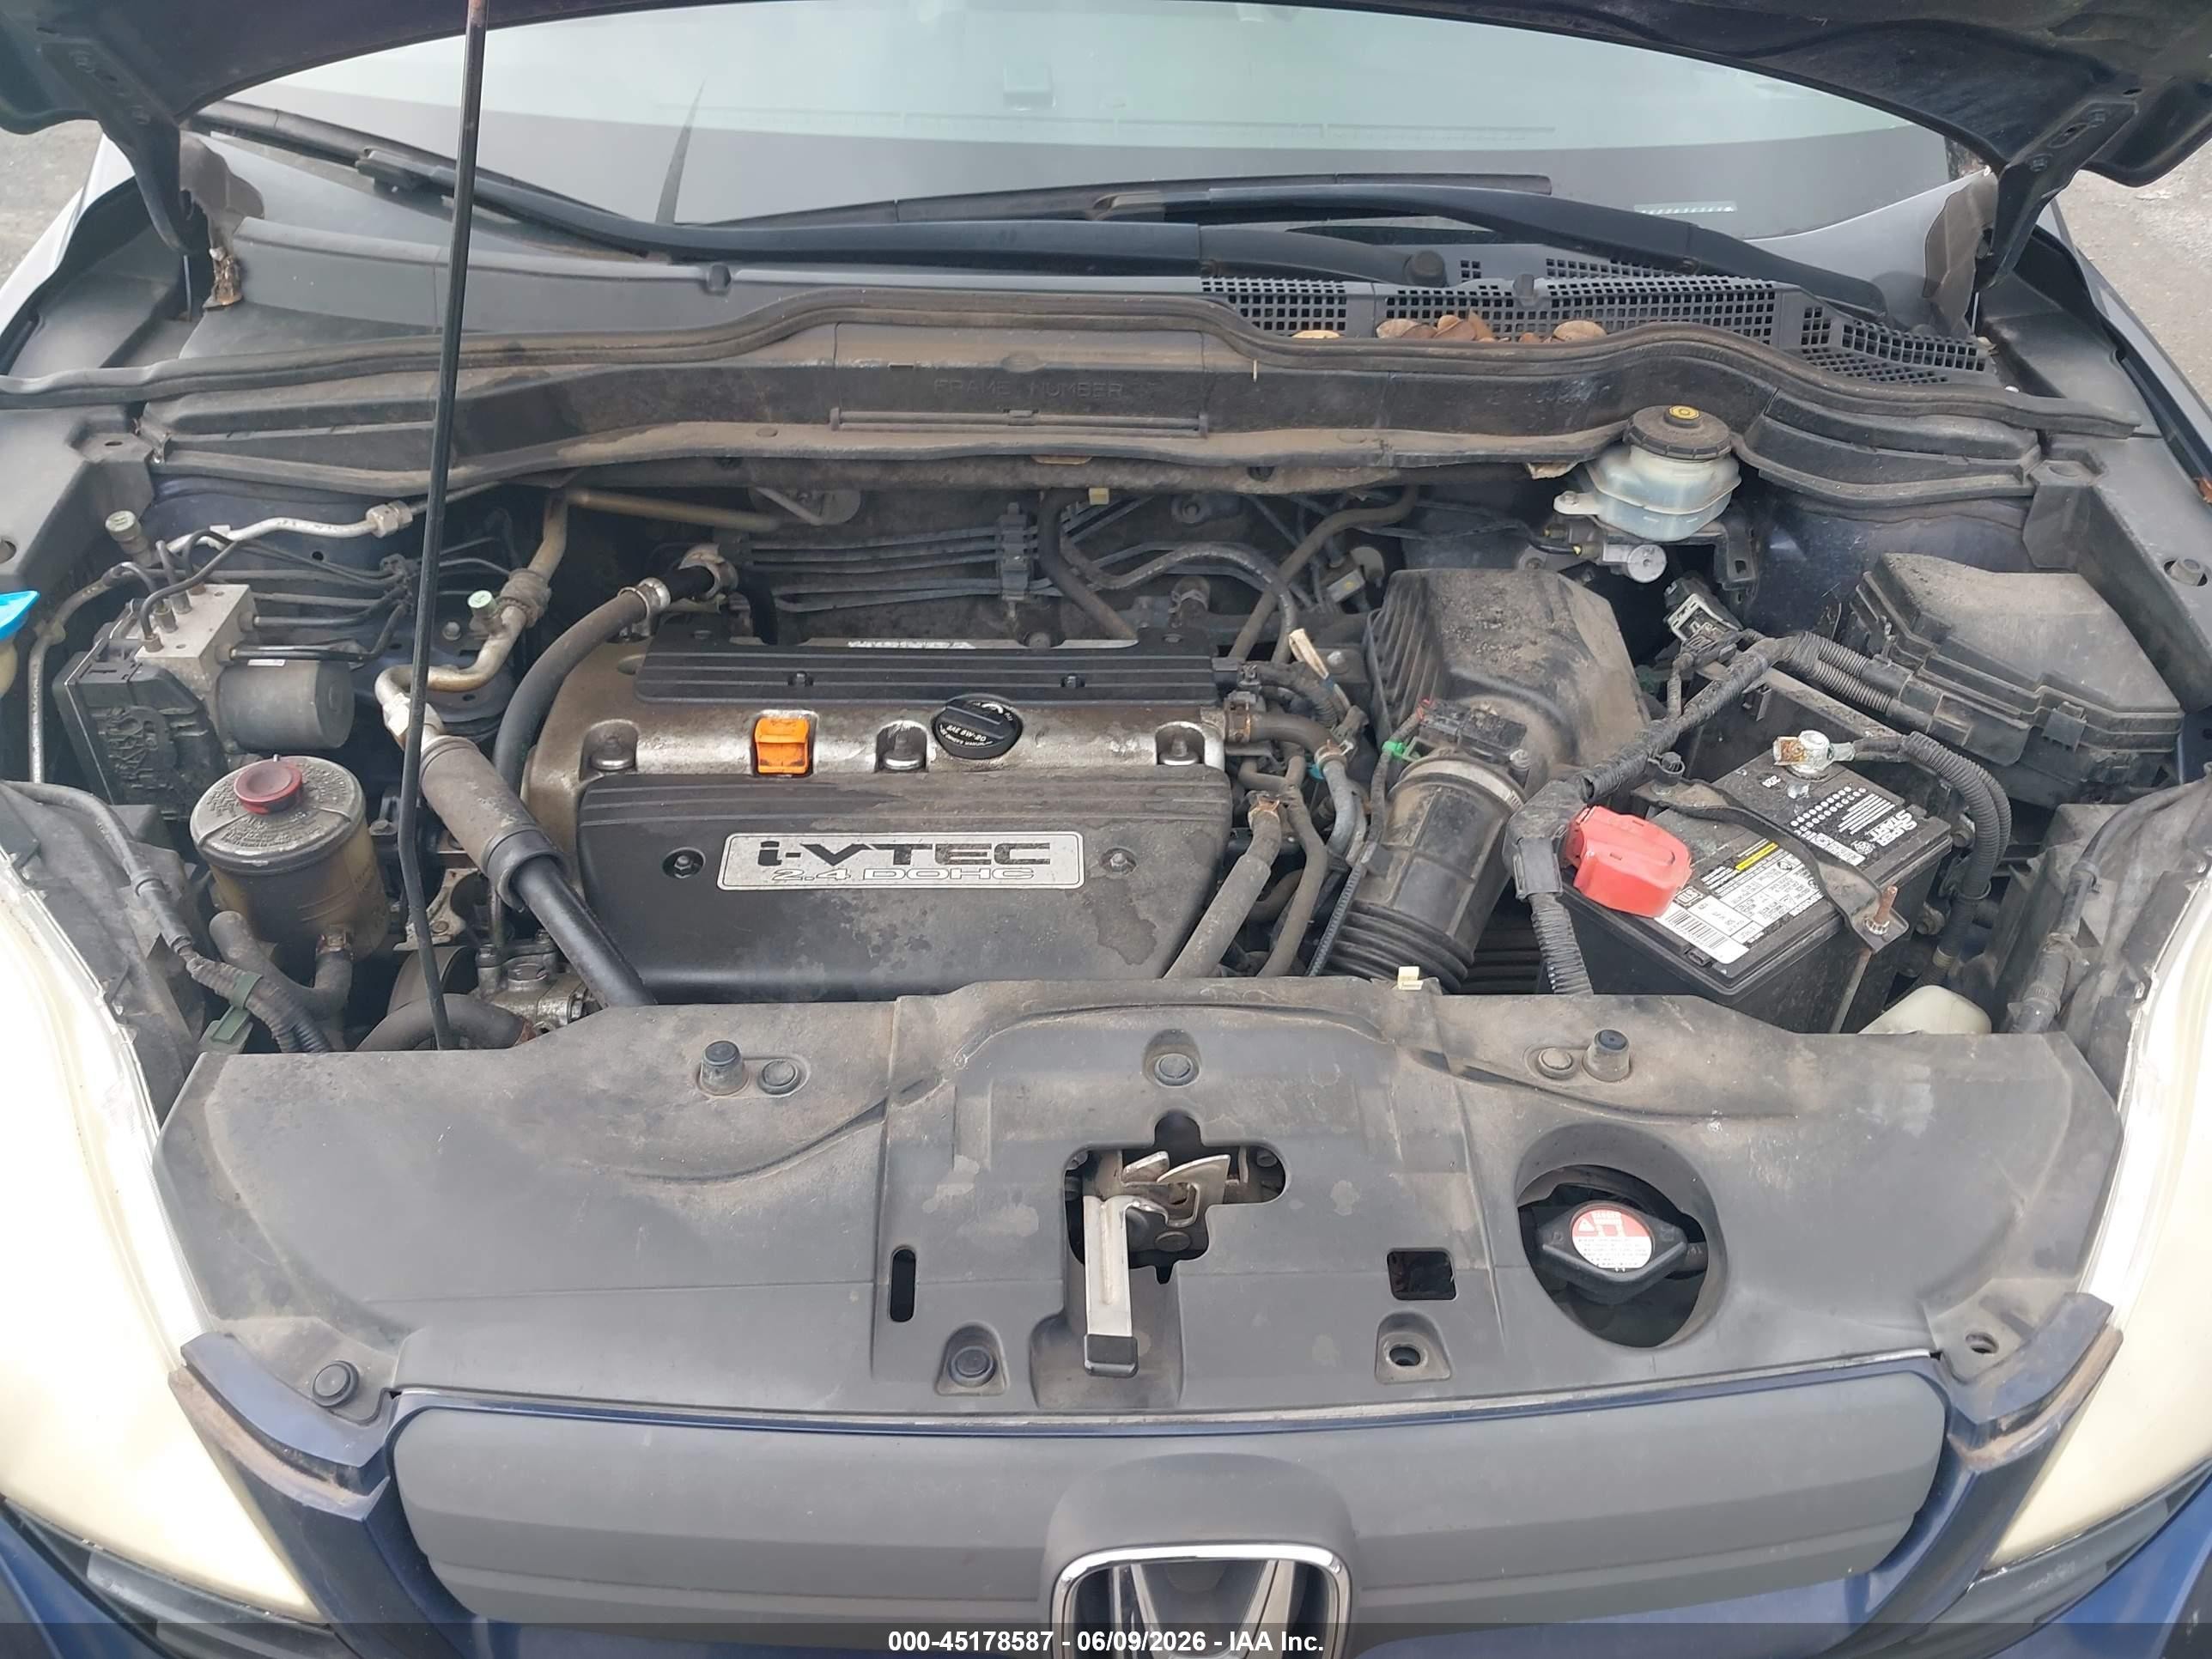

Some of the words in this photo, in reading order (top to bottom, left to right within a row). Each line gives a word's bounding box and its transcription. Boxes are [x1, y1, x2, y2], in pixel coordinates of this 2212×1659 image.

[933, 379, 1011, 396] FRAME
[1030, 380, 1123, 398] NUMBER
[946, 725, 962, 734] SAE
[1869, 809, 1913, 842] START
[1876, 819, 1918, 847] SUPER
[757, 841, 1051, 866] i-VTEC
[772, 867, 852, 881] 2.4
[862, 867, 1036, 881] DOHC
